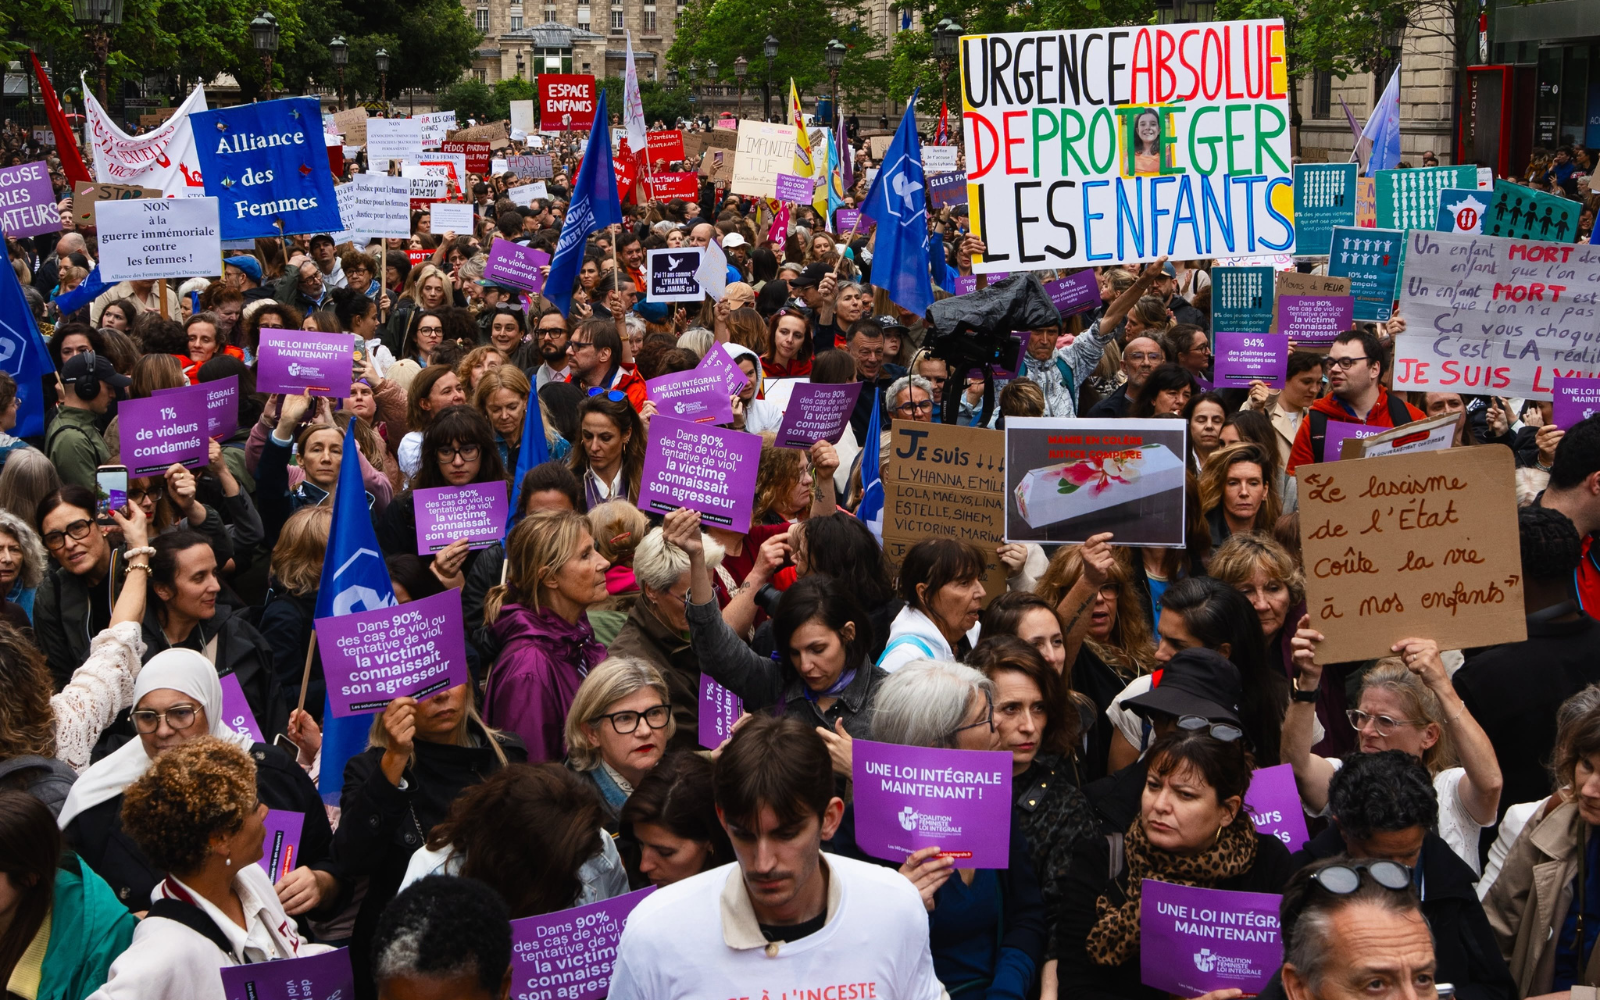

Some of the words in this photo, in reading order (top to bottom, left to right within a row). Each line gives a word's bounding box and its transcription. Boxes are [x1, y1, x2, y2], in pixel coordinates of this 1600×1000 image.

[963, 32, 1130, 109] URGENCE
[1131, 25, 1287, 105] ABSOLUE
[548, 83, 590, 99] ESPACE
[546, 99, 593, 113] ENFANTS
[215, 131, 305, 154] Alliance
[444, 142, 464, 152] PÉDOS
[466, 144, 489, 152] PARTOUT
[964, 110, 1029, 180] DE
[1032, 97, 1290, 179] PROTÉGER
[508, 156, 552, 168] HONTE
[746, 157, 778, 173] TUE
[241, 167, 274, 187] des
[931, 175, 954, 187] ELLES
[356, 183, 373, 192] Justice
[374, 186, 386, 194] pour
[143, 202, 170, 212] NON
[234, 197, 319, 219] Femmes
[149, 216, 155, 225] à
[157, 216, 166, 225] la
[980, 180, 1077, 263] LES
[1081, 174, 1294, 262] ENFANTS
[102, 233, 138, 244] guerre
[141, 227, 214, 240] immémoriale
[142, 244, 177, 252] contre
[514, 250, 526, 260] 1%
[1414, 233, 1439, 255] Un
[1449, 240, 1495, 263] enfant
[1508, 244, 1575, 264] MORT
[127, 257, 142, 266] les
[144, 256, 187, 266] femmes
[189, 254, 193, 263] !
[497, 254, 507, 264] de
[508, 258, 538, 273] violeurs
[1450, 258, 1498, 279] enfant
[1511, 267, 1538, 282] que
[1546, 265, 1575, 280] l'on
[493, 263, 537, 282] condamnés
[661, 277, 690, 286] LYHANNA,
[666, 285, 685, 293] JAMAIS
[1408, 276, 1428, 298] Un
[1436, 280, 1483, 305] enfant
[1492, 282, 1567, 304] MORT
[1573, 292, 1597, 305] est
[1451, 301, 1477, 318] que
[1485, 301, 1517, 315] l'on
[1525, 304, 1550, 316] n'a
[1558, 306, 1594, 324] pas
[1433, 313, 1463, 337] Ça
[1482, 324, 1523, 338] vous
[1240, 350, 1263, 358] plaintes
[1243, 338, 1265, 348] 94%
[1433, 336, 1491, 359] C'est
[1502, 339, 1541, 362] LA
[1397, 359, 1430, 385] JE
[1439, 360, 1511, 390] SUIS
[160, 406, 177, 420] 1%
[135, 427, 154, 441] de
[156, 421, 199, 438] violeurs
[676, 428, 699, 443] Dans
[700, 434, 724, 449] 90%
[1048, 434, 1083, 446] MAMIE
[1085, 434, 1100, 446] EN
[1102, 433, 1143, 446] COLÈRE
[133, 437, 201, 458] condamnés
[659, 436, 677, 447] des
[677, 441, 693, 452] cas
[694, 442, 708, 455] de
[709, 447, 728, 459] viol
[729, 452, 743, 463] ou
[895, 428, 928, 462] JE
[1048, 449, 1086, 460] JUSTICE
[1089, 449, 1143, 460] COMPLICE
[661, 447, 700, 463] tentative
[701, 454, 715, 466] de
[717, 458, 737, 473] viol,
[665, 457, 678, 470] la
[679, 461, 726, 482] victime
[657, 469, 729, 496] connaissait
[897, 466, 966, 491] LYHANNA,
[649, 480, 669, 495] son
[671, 486, 736, 509] agresseur
[896, 485, 931, 502] LOLA,
[1308, 520, 1348, 540] de
[1360, 498, 1459, 535] l'État
[1314, 547, 1379, 579] coûte
[1398, 551, 1435, 572] la
[1443, 537, 1486, 566] vie
[1359, 593, 1405, 617] nos
[336, 636, 360, 648] des
[363, 630, 387, 642] cas
[389, 625, 406, 639] de
[408, 618, 430, 634] viol
[431, 615, 446, 627] ou
[357, 619, 390, 634] Dans
[392, 609, 423, 627] 90%
[342, 640, 400, 657] tentative
[403, 633, 419, 648] de
[421, 624, 444, 640] viol,
[349, 649, 441, 682] connaissait
[355, 654, 372, 668] la
[374, 641, 436, 666] victime
[341, 682, 372, 696] son
[375, 660, 450, 694] agresseur
[866, 761, 892, 777] UNE
[895, 766, 917, 782] LOI
[920, 767, 1002, 786] INTÉGRALE
[881, 780, 975, 800] MAINTENANT
[977, 787, 983, 801] !
[1157, 902, 1187, 919] UNE
[1191, 908, 1216, 925] LOI
[1175, 920, 1277, 944] MAINTENANT
